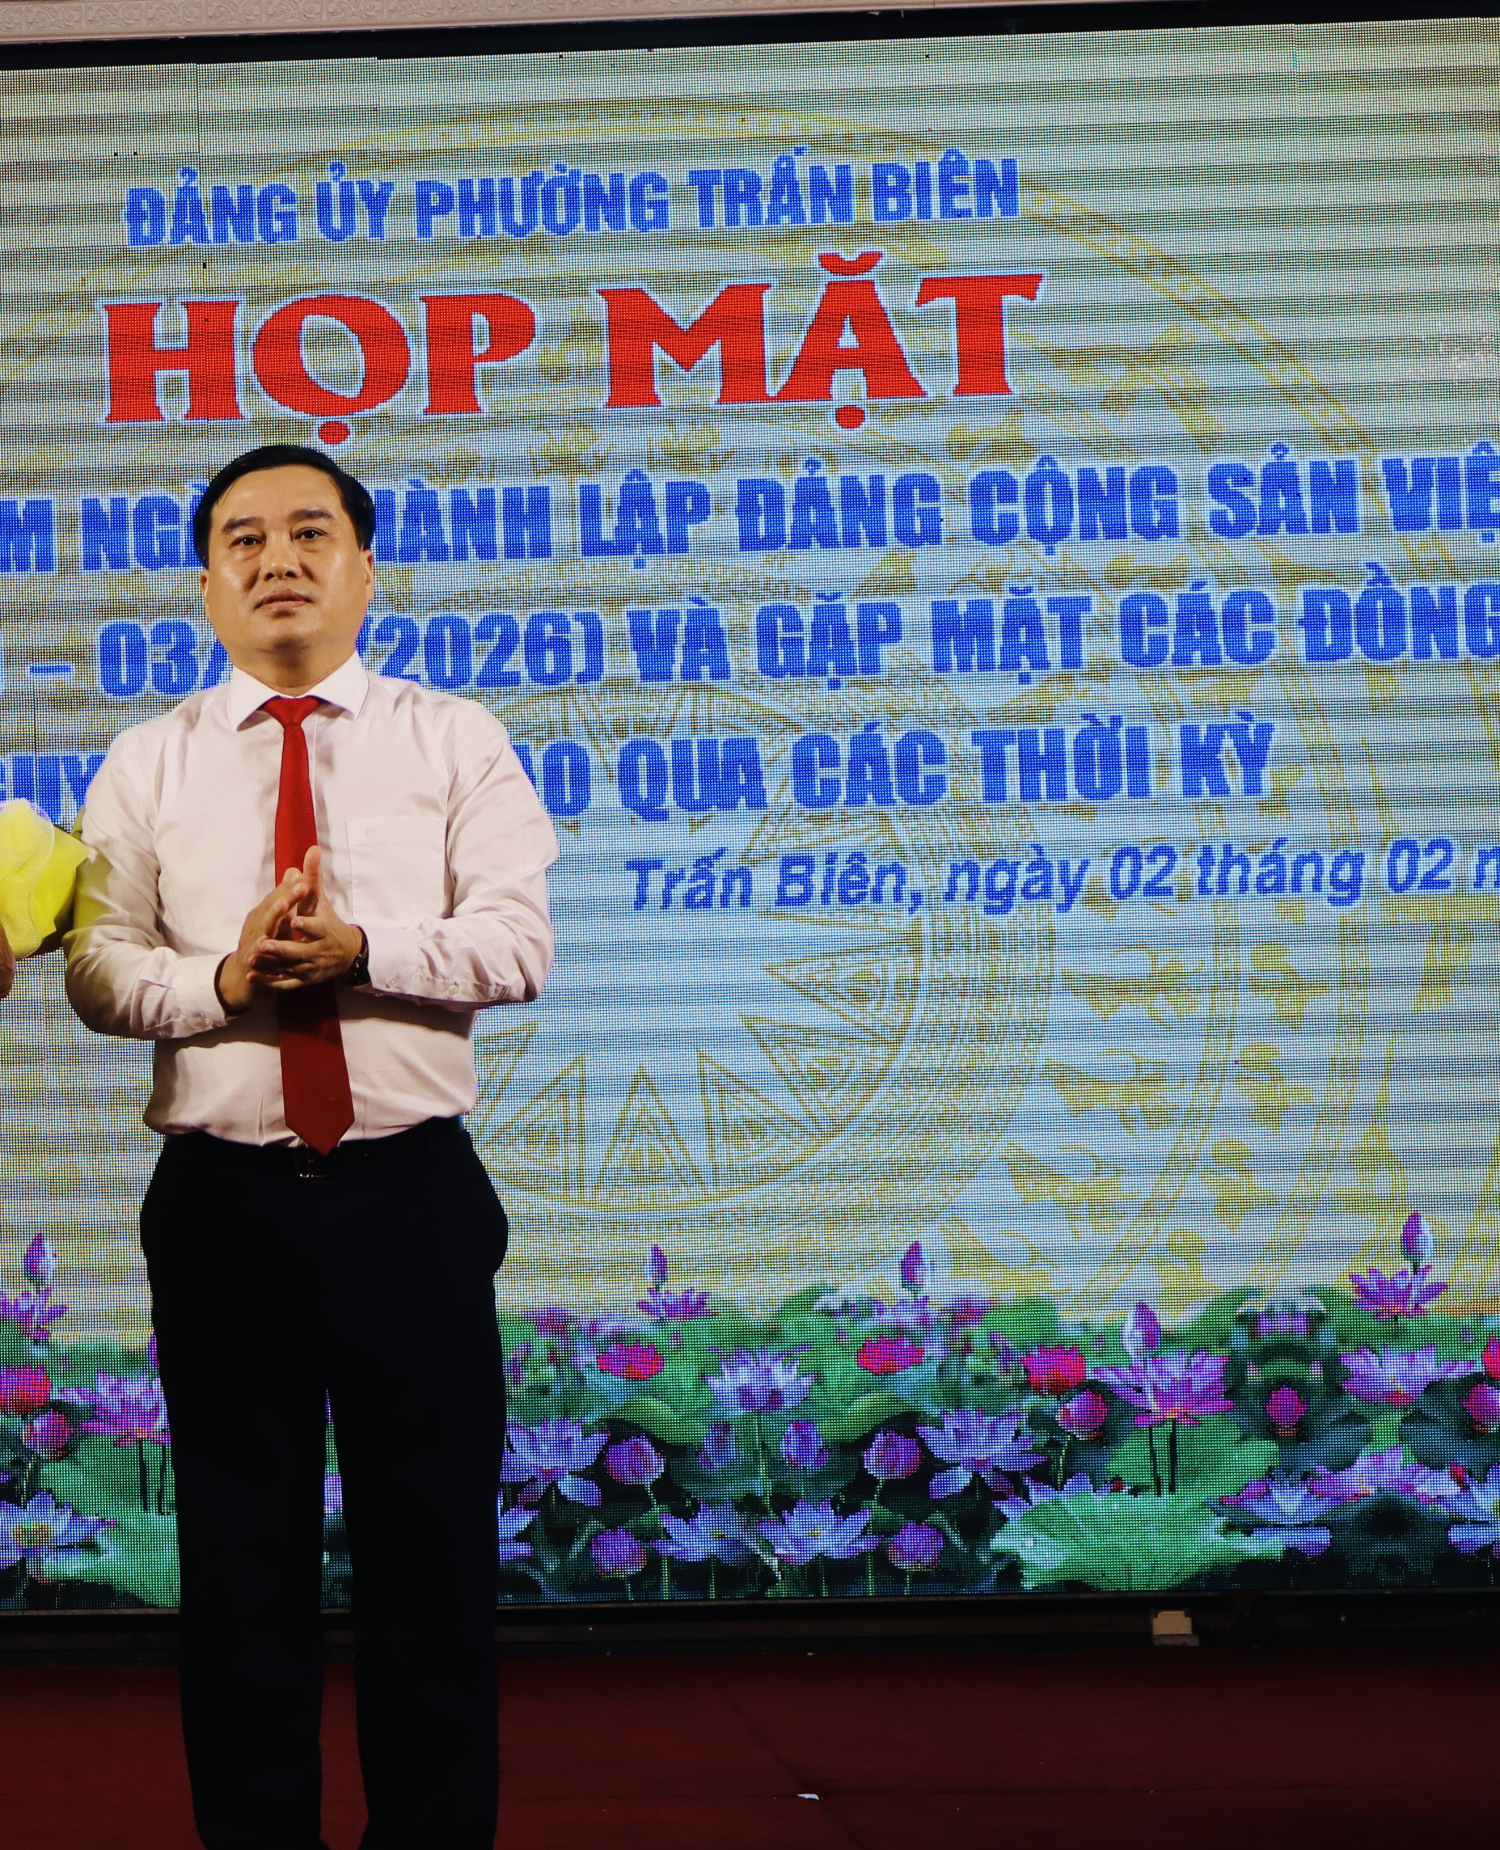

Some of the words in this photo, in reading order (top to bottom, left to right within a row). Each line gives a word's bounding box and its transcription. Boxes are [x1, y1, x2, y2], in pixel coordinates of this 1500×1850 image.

[126, 166, 297, 245] ĐẢNG
[314, 161, 394, 242] ỦY
[417, 163, 669, 239] PHƯỜNG
[690, 147, 854, 230] TRẤN
[872, 148, 1019, 223] BIÊN
[104, 293, 536, 445] HỌP
[597, 251, 1045, 429] MẶT
[580, 468, 710, 570] LẬP
[735, 459, 942, 552] ĐẢNG
[969, 455, 1179, 557] CỘNG
[1207, 443, 1358, 540] SẢN
[627, 597, 731, 681] VÀ
[756, 593, 901, 691] GẶP
[931, 586, 1094, 685] MẶT
[1118, 581, 1276, 668] CÁC
[1299, 560, 1500, 664] ĐỒNG
[617, 735, 767, 822] QUA
[791, 721, 947, 809] CÁC
[971, 713, 1149, 803] THỜI
[1180, 710, 1274, 797] KỲ
[625, 846, 751, 911] Trấn
[775, 852, 924, 914] Biên,
[945, 844, 1088, 915] ngày
[1110, 845, 1178, 900] 02
[1198, 837, 1366, 906] tháng
[1387, 838, 1455, 893] 02
